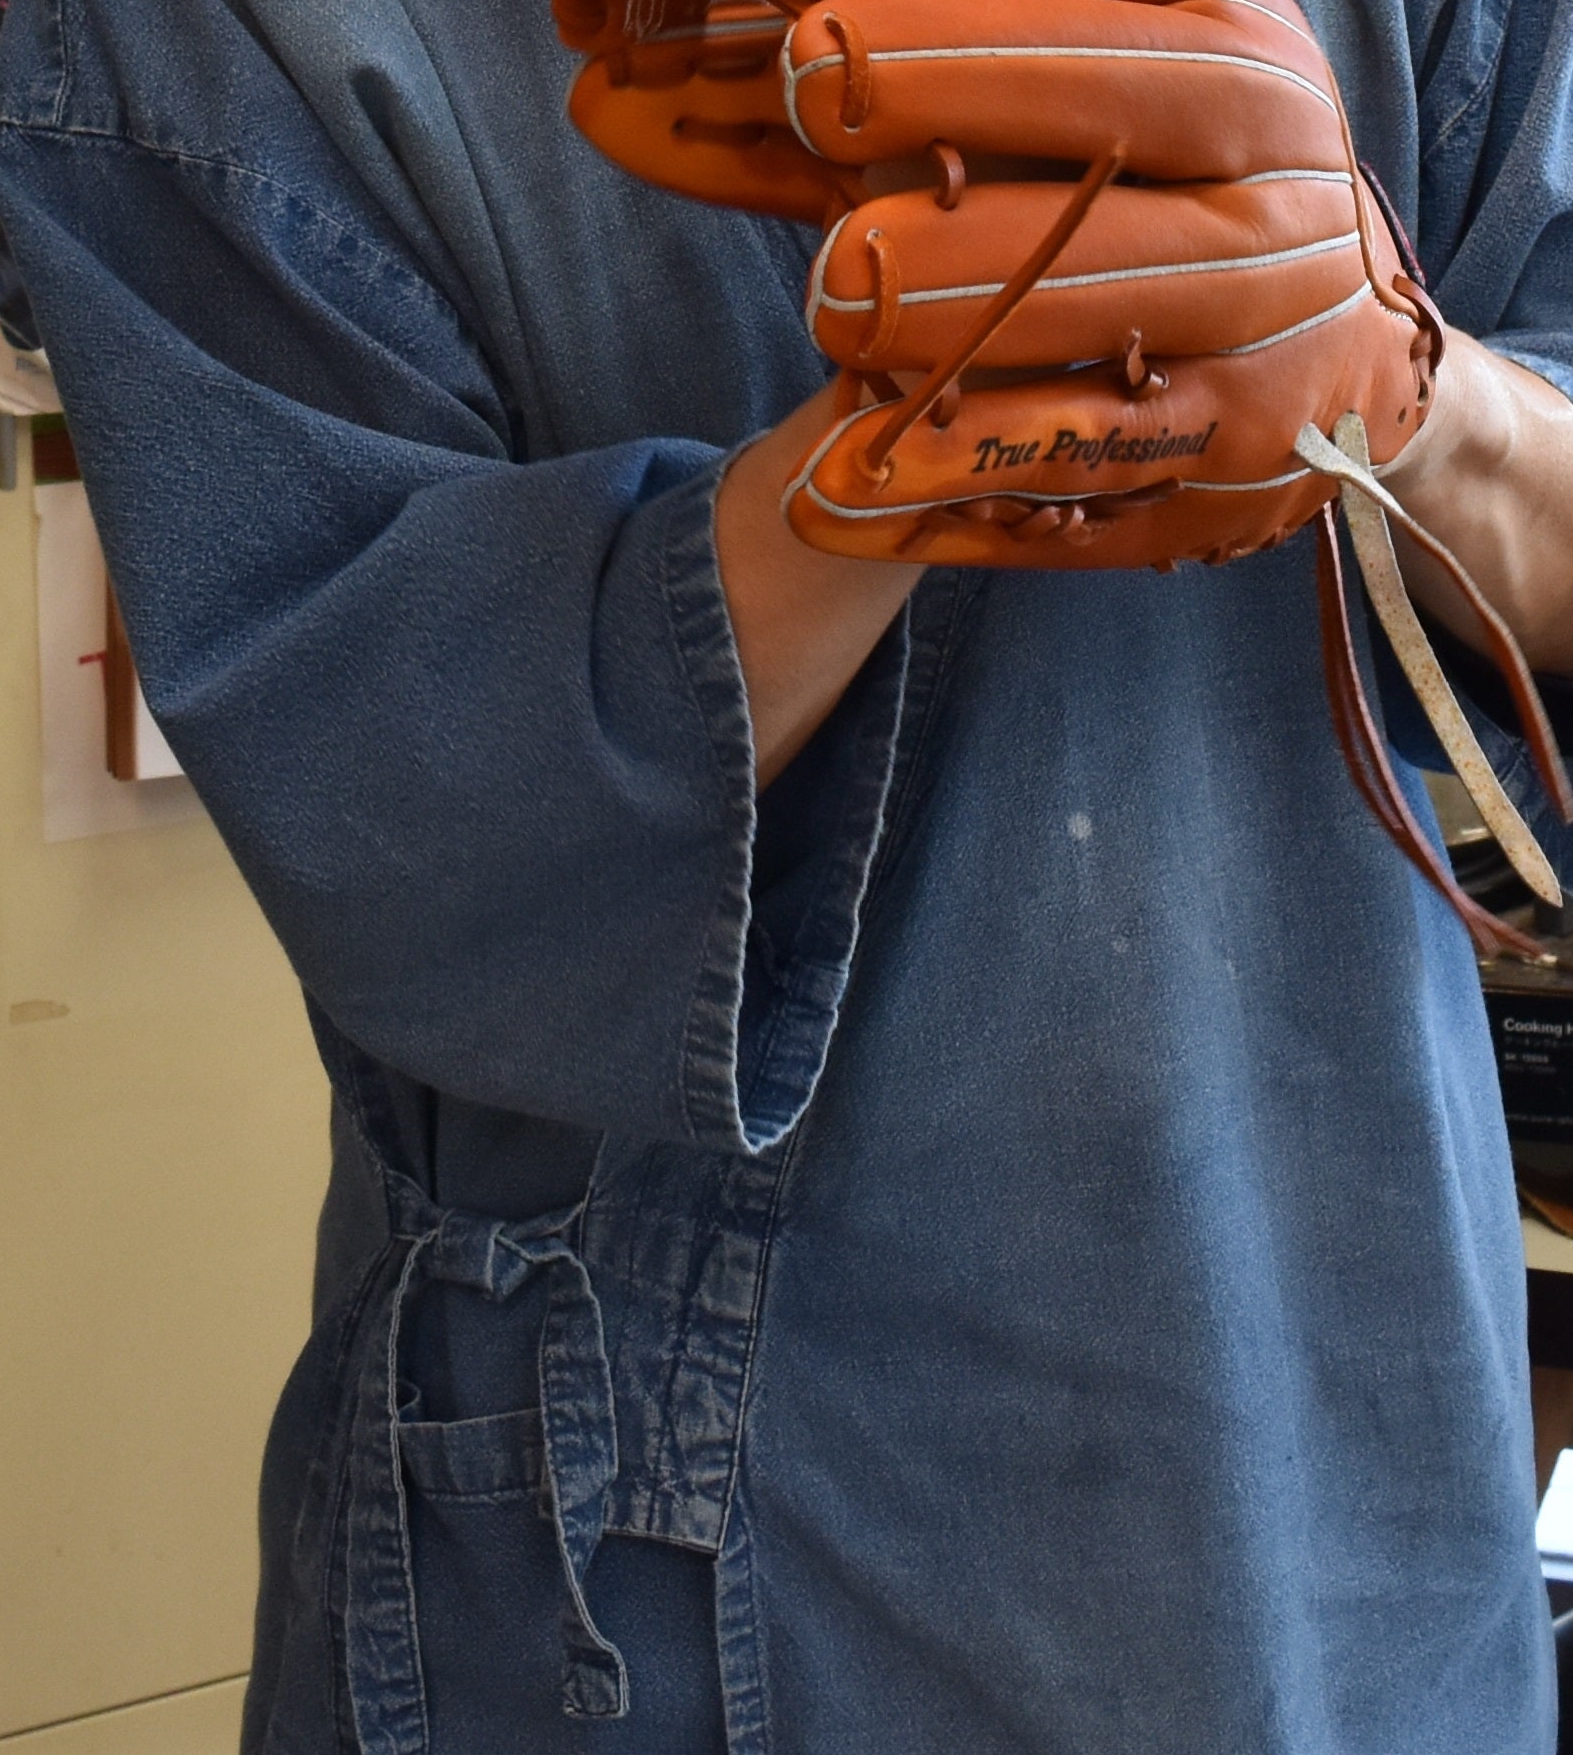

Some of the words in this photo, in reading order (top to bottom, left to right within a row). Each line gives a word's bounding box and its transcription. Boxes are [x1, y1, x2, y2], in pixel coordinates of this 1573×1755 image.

[970, 436, 1041, 474] True
[1041, 420, 1219, 471] Professional
[1503, 1017, 1563, 1038] Cooking
